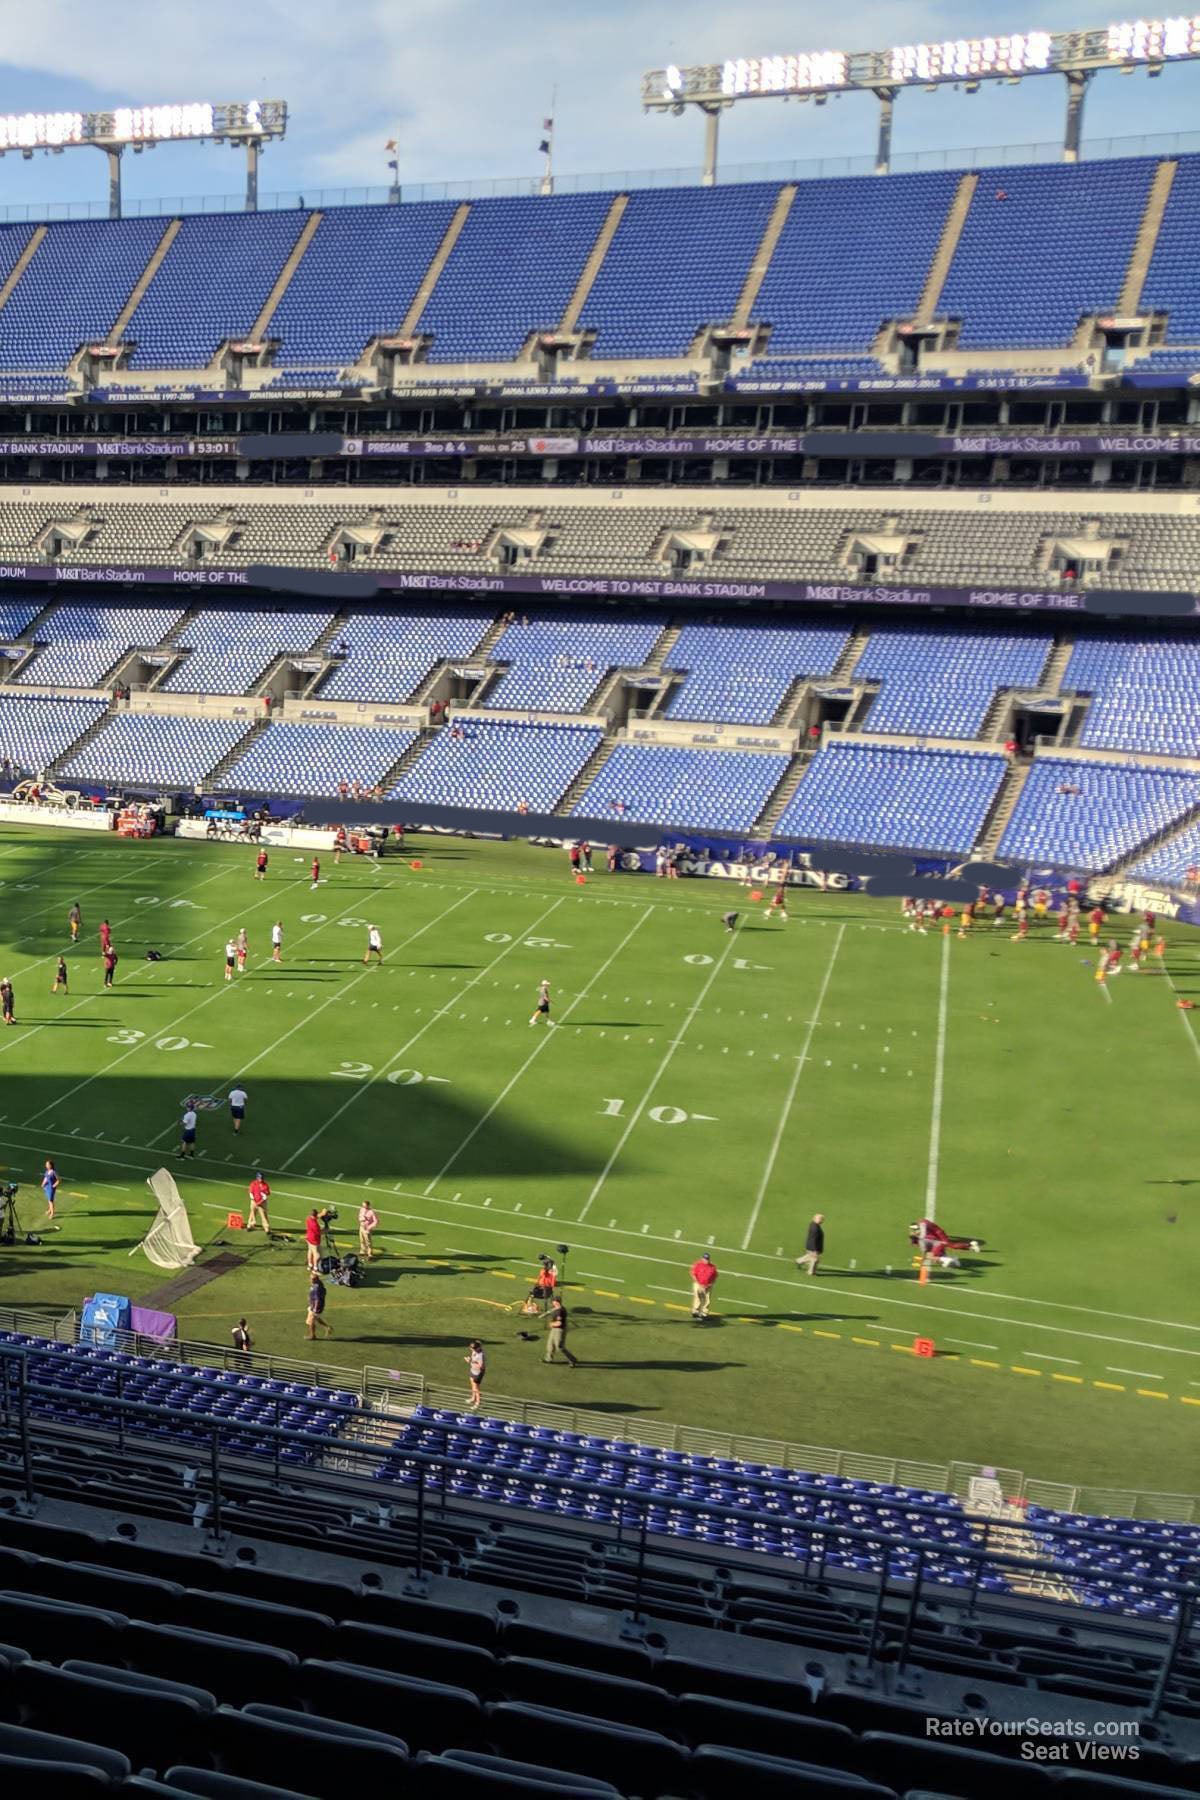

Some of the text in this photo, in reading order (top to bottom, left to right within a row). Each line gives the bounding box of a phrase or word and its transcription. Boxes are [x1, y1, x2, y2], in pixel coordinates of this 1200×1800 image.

[10, 443, 38, 454] BANK
[40, 443, 84, 454] STADIUM
[96, 442, 184, 454] M&T Bank Stadium
[198, 443, 229, 454] 53:01
[367, 442, 409, 453] PREGAME
[456, 442, 466, 453] 4
[510, 440, 526, 452] 25
[616, 440, 645, 452] Bank
[645, 440, 693, 452] Stadium
[705, 439, 797, 451] HOME OF THE
[989, 438, 1024, 451] Bank
[1024, 438, 1080, 452] Stadium
[1099, 438, 1180, 451] WELCOME
[55, 568, 145, 582] M&T Bank Stadium
[173, 571, 248, 584] HOME OF THE
[400, 575, 504, 590] M&T Bank Stadium
[541, 579, 766, 597] WELCOME TO M&T BANK STADIUM
[841, 587, 874, 601] Bank
[874, 588, 931, 603] Stadium
[969, 591, 1079, 608] HOME OF THE
[300, 913, 368, 927] 30
[483, 933, 556, 948] 20
[684, 953, 751, 970] 10
[106, 1029, 189, 1052] 30
[330, 1062, 422, 1085] 20
[597, 1098, 688, 1124] 10
